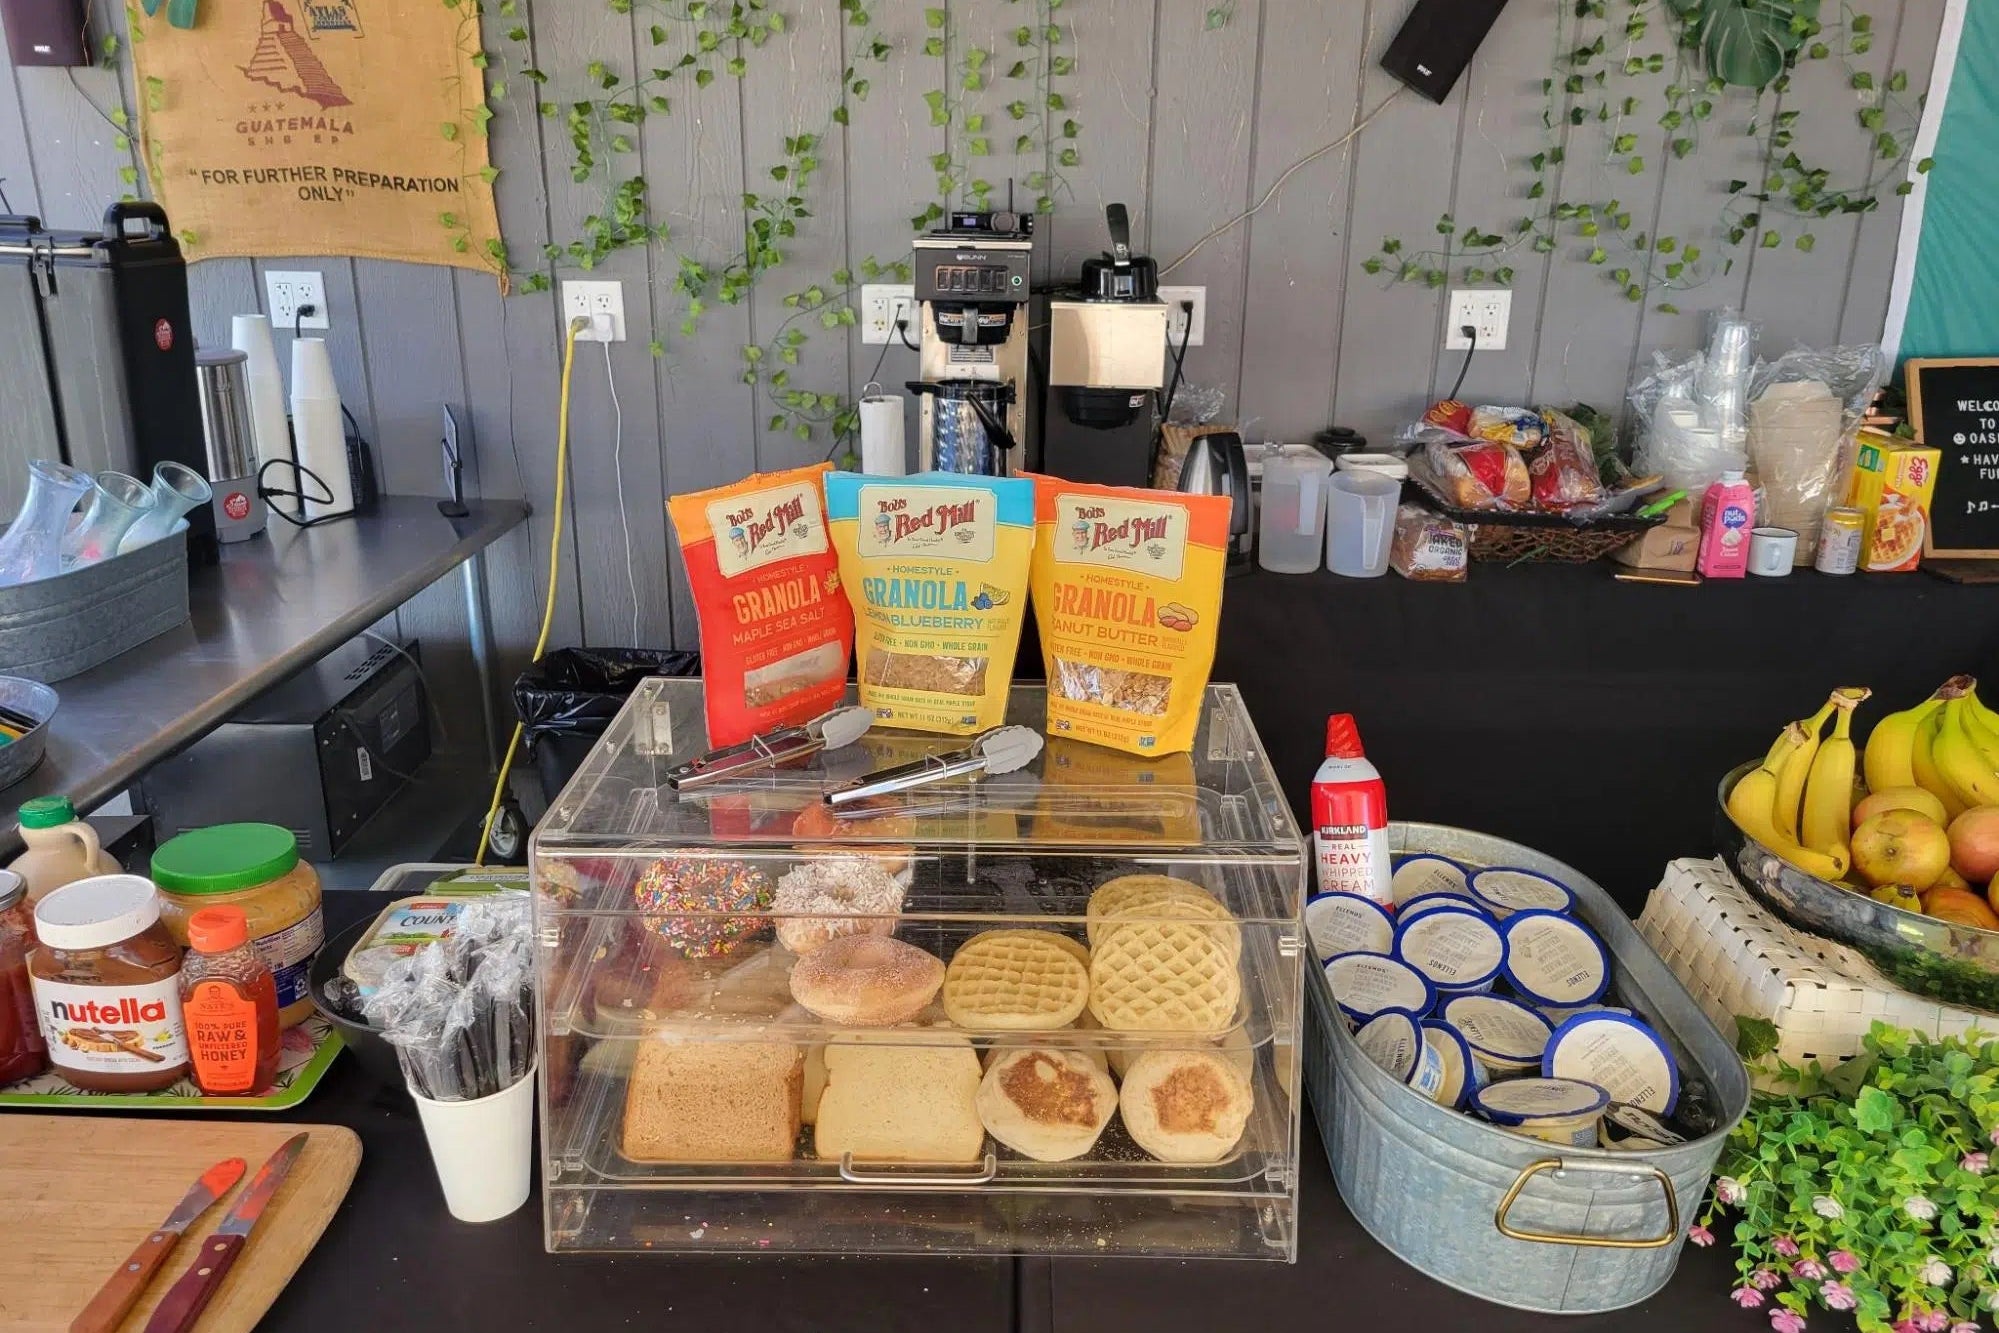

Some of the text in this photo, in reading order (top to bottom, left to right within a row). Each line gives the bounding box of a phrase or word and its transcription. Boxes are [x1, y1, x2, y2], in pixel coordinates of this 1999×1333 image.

[236, 116, 354, 135] GUATEMALA
[243, 165, 328, 184] FURTHER
[333, 167, 460, 193] PREPARATION
[1979, 418, 1996, 430] TO
[1969, 432, 1999, 444] OAS
[1909, 456, 1928, 487] Eggo
[878, 498, 907, 513] Bob's
[1724, 509, 1739, 517] nut
[746, 494, 805, 555] Red Mill
[894, 499, 976, 544] Red Mill
[1724, 512, 1746, 524] pods
[1090, 517, 1129, 552] Red
[1129, 514, 1167, 548] Mill
[1429, 533, 1463, 548] AKED
[1428, 544, 1463, 556] ORGANIC
[757, 564, 805, 583] HOMESTYLE
[892, 565, 953, 576] HOMESTYLE
[1086, 573, 1144, 591] HOMESTYLE
[732, 574, 822, 625] GRANOLA
[863, 577, 968, 611] GRANOLA
[1053, 581, 1156, 629] GRANOLA
[732, 606, 825, 646] MAPLE SEA SALT
[891, 614, 983, 630] BLUEBERRY
[1052, 615, 1095, 637] ANUT
[1097, 625, 1159, 648] BUTTER
[904, 639, 918, 648] NON
[942, 641, 966, 651] WHOLE
[967, 642, 988, 651] GRAIN
[1321, 825, 1366, 835] KIRKLAND
[1321, 852, 1372, 865] HEAVY
[1321, 867, 1374, 878] WHIPPED
[1433, 868, 1456, 889] ELLENOS
[1322, 879, 1375, 892] CREAM
[1428, 959, 1457, 976] ELLENOS
[1565, 970, 1590, 988] ELLENOS
[51, 998, 166, 1025] nutella
[195, 1021, 247, 1030] 100% PURE
[197, 1029, 247, 1042] RAW &
[199, 1041, 248, 1050] UNFILTERED
[200, 1049, 247, 1061] HONEY
[1627, 1085, 1656, 1108] ELLENO
